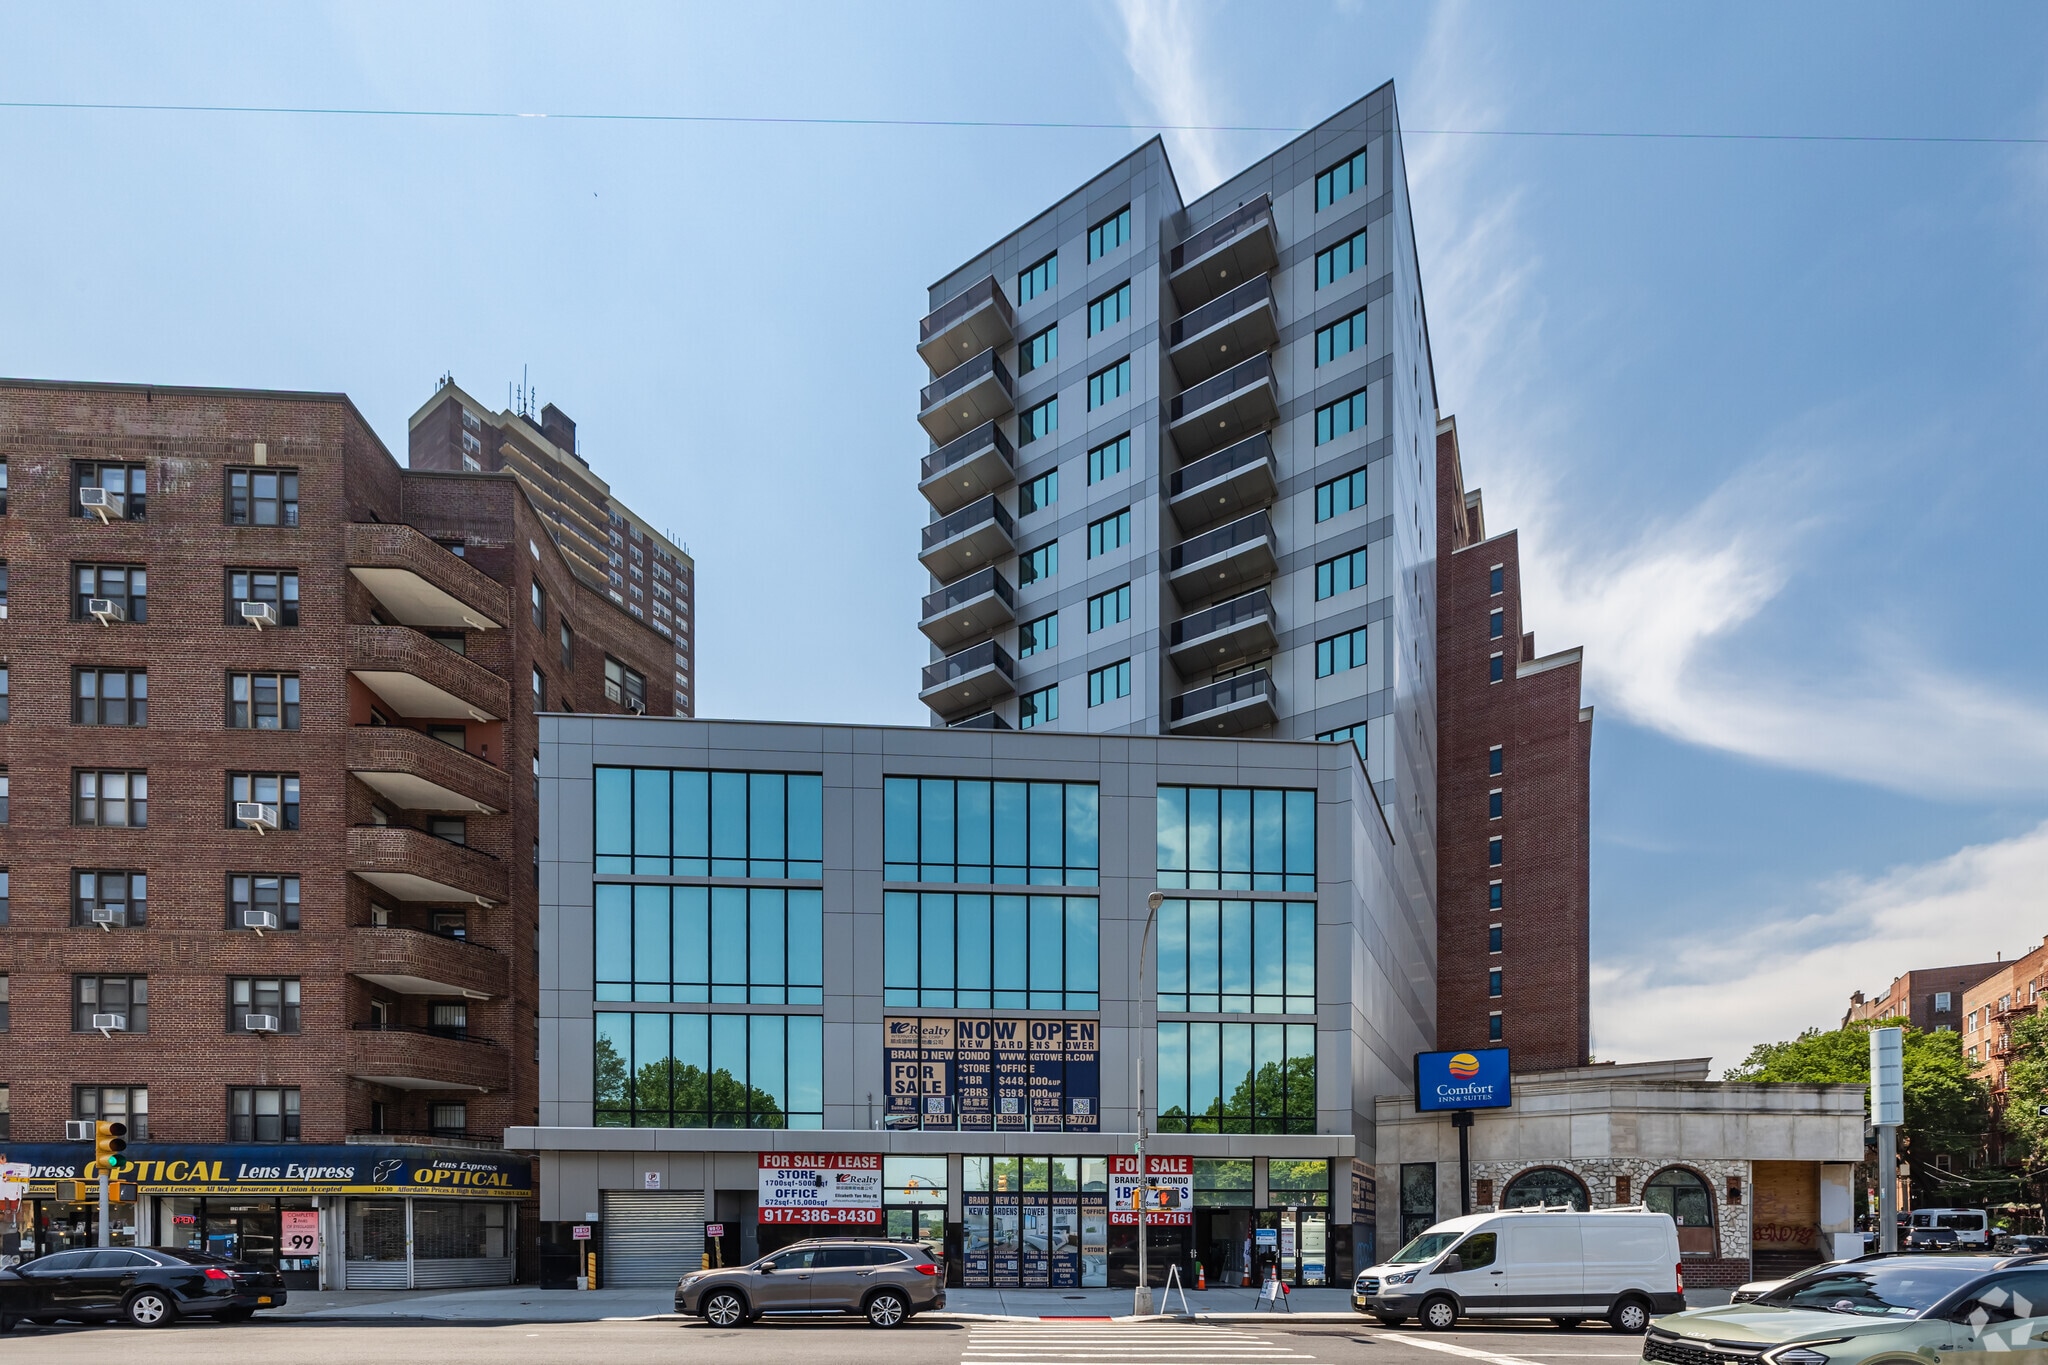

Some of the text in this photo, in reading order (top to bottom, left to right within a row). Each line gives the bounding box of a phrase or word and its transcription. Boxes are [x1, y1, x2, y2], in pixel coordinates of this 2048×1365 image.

[910, 1025, 951, 1037] Realty
[959, 1021, 1095, 1040] NOW OPEN
[960, 1040, 1095, 1050] KEW GARDENS TOWER
[891, 1050, 1094, 1062] BRAND NEW CONDO WWW.KGTOWER.COM
[895, 1065, 934, 1079] FOR
[894, 1080, 942, 1094] SALE
[1436, 1082, 1494, 1096] Comfort
[432, 1160, 498, 1171] Lens Express
[764, 1155, 790, 1167] FOR
[794, 1156, 826, 1168] SALE
[838, 1156, 877, 1168] LEASE
[1150, 1158, 1187, 1172] SALE
[30, 1160, 355, 1181] press OPTICAL Lens Express
[778, 1170, 816, 1179] STORE
[414, 1168, 513, 1186] OPTICAL
[850, 1175, 878, 1184] Realty
[776, 1189, 818, 1198] OFFICE
[968, 1196, 989, 1204] BRAND
[996, 1196, 1010, 1204] NEW
[1010, 1196, 1035, 1205] CONDO
[172, 1216, 195, 1224] OPEN
[764, 1209, 876, 1222] 917-386-8430
[1112, 1214, 1190, 1224] 646-41-7161
